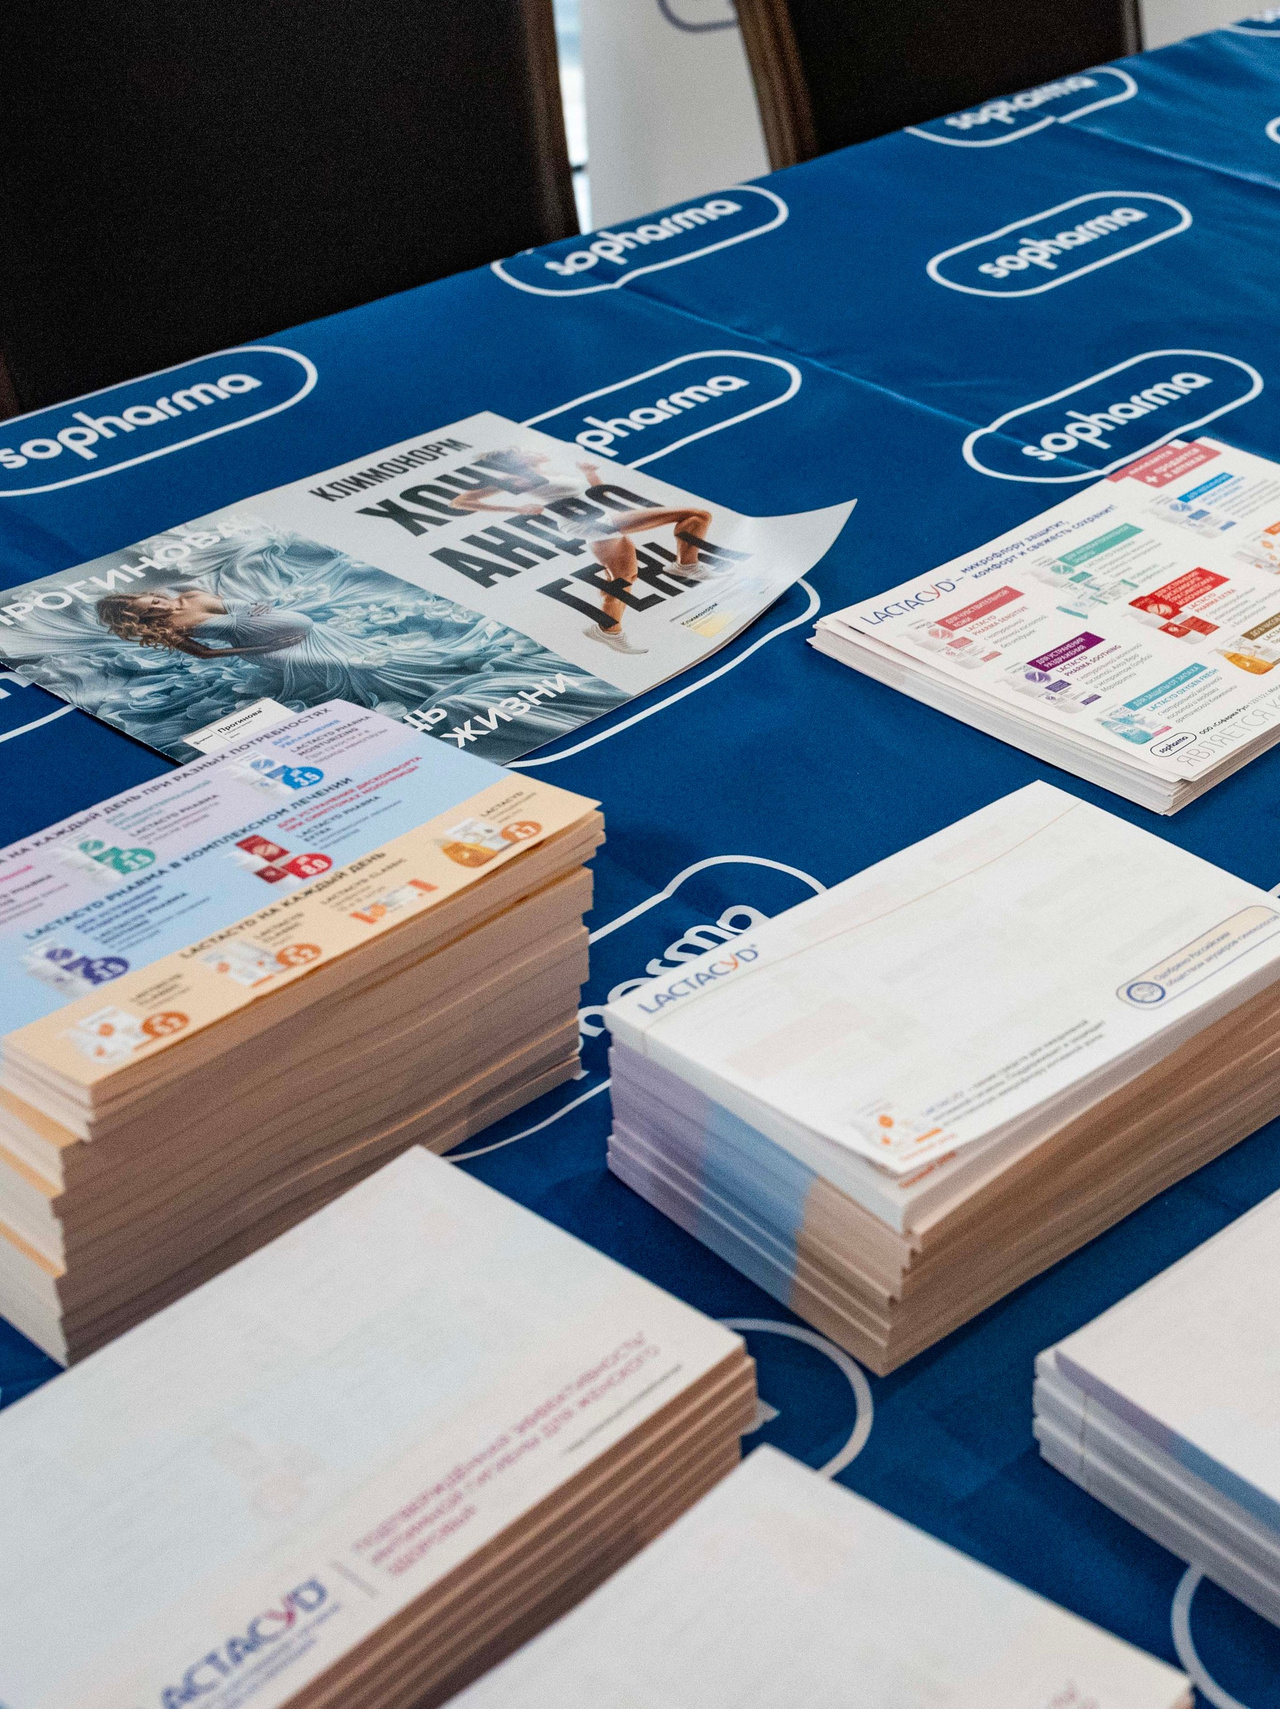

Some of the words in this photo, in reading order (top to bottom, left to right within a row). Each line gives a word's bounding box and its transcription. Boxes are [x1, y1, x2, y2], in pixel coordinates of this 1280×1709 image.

[544, 193, 743, 277] sopharma
[977, 206, 1148, 278] sopharma
[0, 371, 263, 468] sopharma
[576, 372, 750, 459] pharma
[1022, 370, 1213, 463] sopharma
[308, 437, 474, 502] КЛИМОНОРМ
[959, 540, 1027, 573] микрофлору
[969, 554, 1020, 579] комфорт
[1024, 528, 1073, 552] свежесть
[860, 579, 957, 626] LACTACYD
[962, 614, 998, 633] LACTACYD
[970, 621, 1000, 636] PHARMA
[996, 605, 1029, 623] SENSITIVE
[1034, 655, 1052, 664] ДЛЯ
[1047, 636, 1086, 658] УСТРАНЕНИЯ
[1043, 644, 1087, 668] РАЗДРАЖЕНИЯ
[1055, 654, 1088, 673] LACTACYD
[1063, 660, 1092, 676] PHARMA
[1088, 644, 1122, 663] SOOTHING
[440, 672, 581, 749] ЖИЗНИ
[1146, 692, 1179, 712] LACTACYD
[1174, 678, 1202, 695] OXYGEN
[1198, 667, 1220, 681] FRESH
[216, 707, 263, 734] Прогинова
[1156, 734, 1191, 755] sopharma
[1175, 708, 1272, 767] ЯВЛЯЕТСЯ
[101, 793, 143, 814] ДЕНЬ
[141, 780, 172, 795] ПРИ
[171, 753, 230, 781] РАЗНЫХ
[230, 707, 330, 754] ПОТРЕБНОСТЯХ
[291, 771, 323, 786] 3.5
[181, 808, 288, 861] КОМПЛЕКСНОМ
[288, 777, 353, 809] ЛЕЧЕНИИ
[346, 850, 388, 873] ДЕНЬ
[637, 945, 760, 1014] LACTACYD
[160, 1574, 328, 1709] ACTACYD
